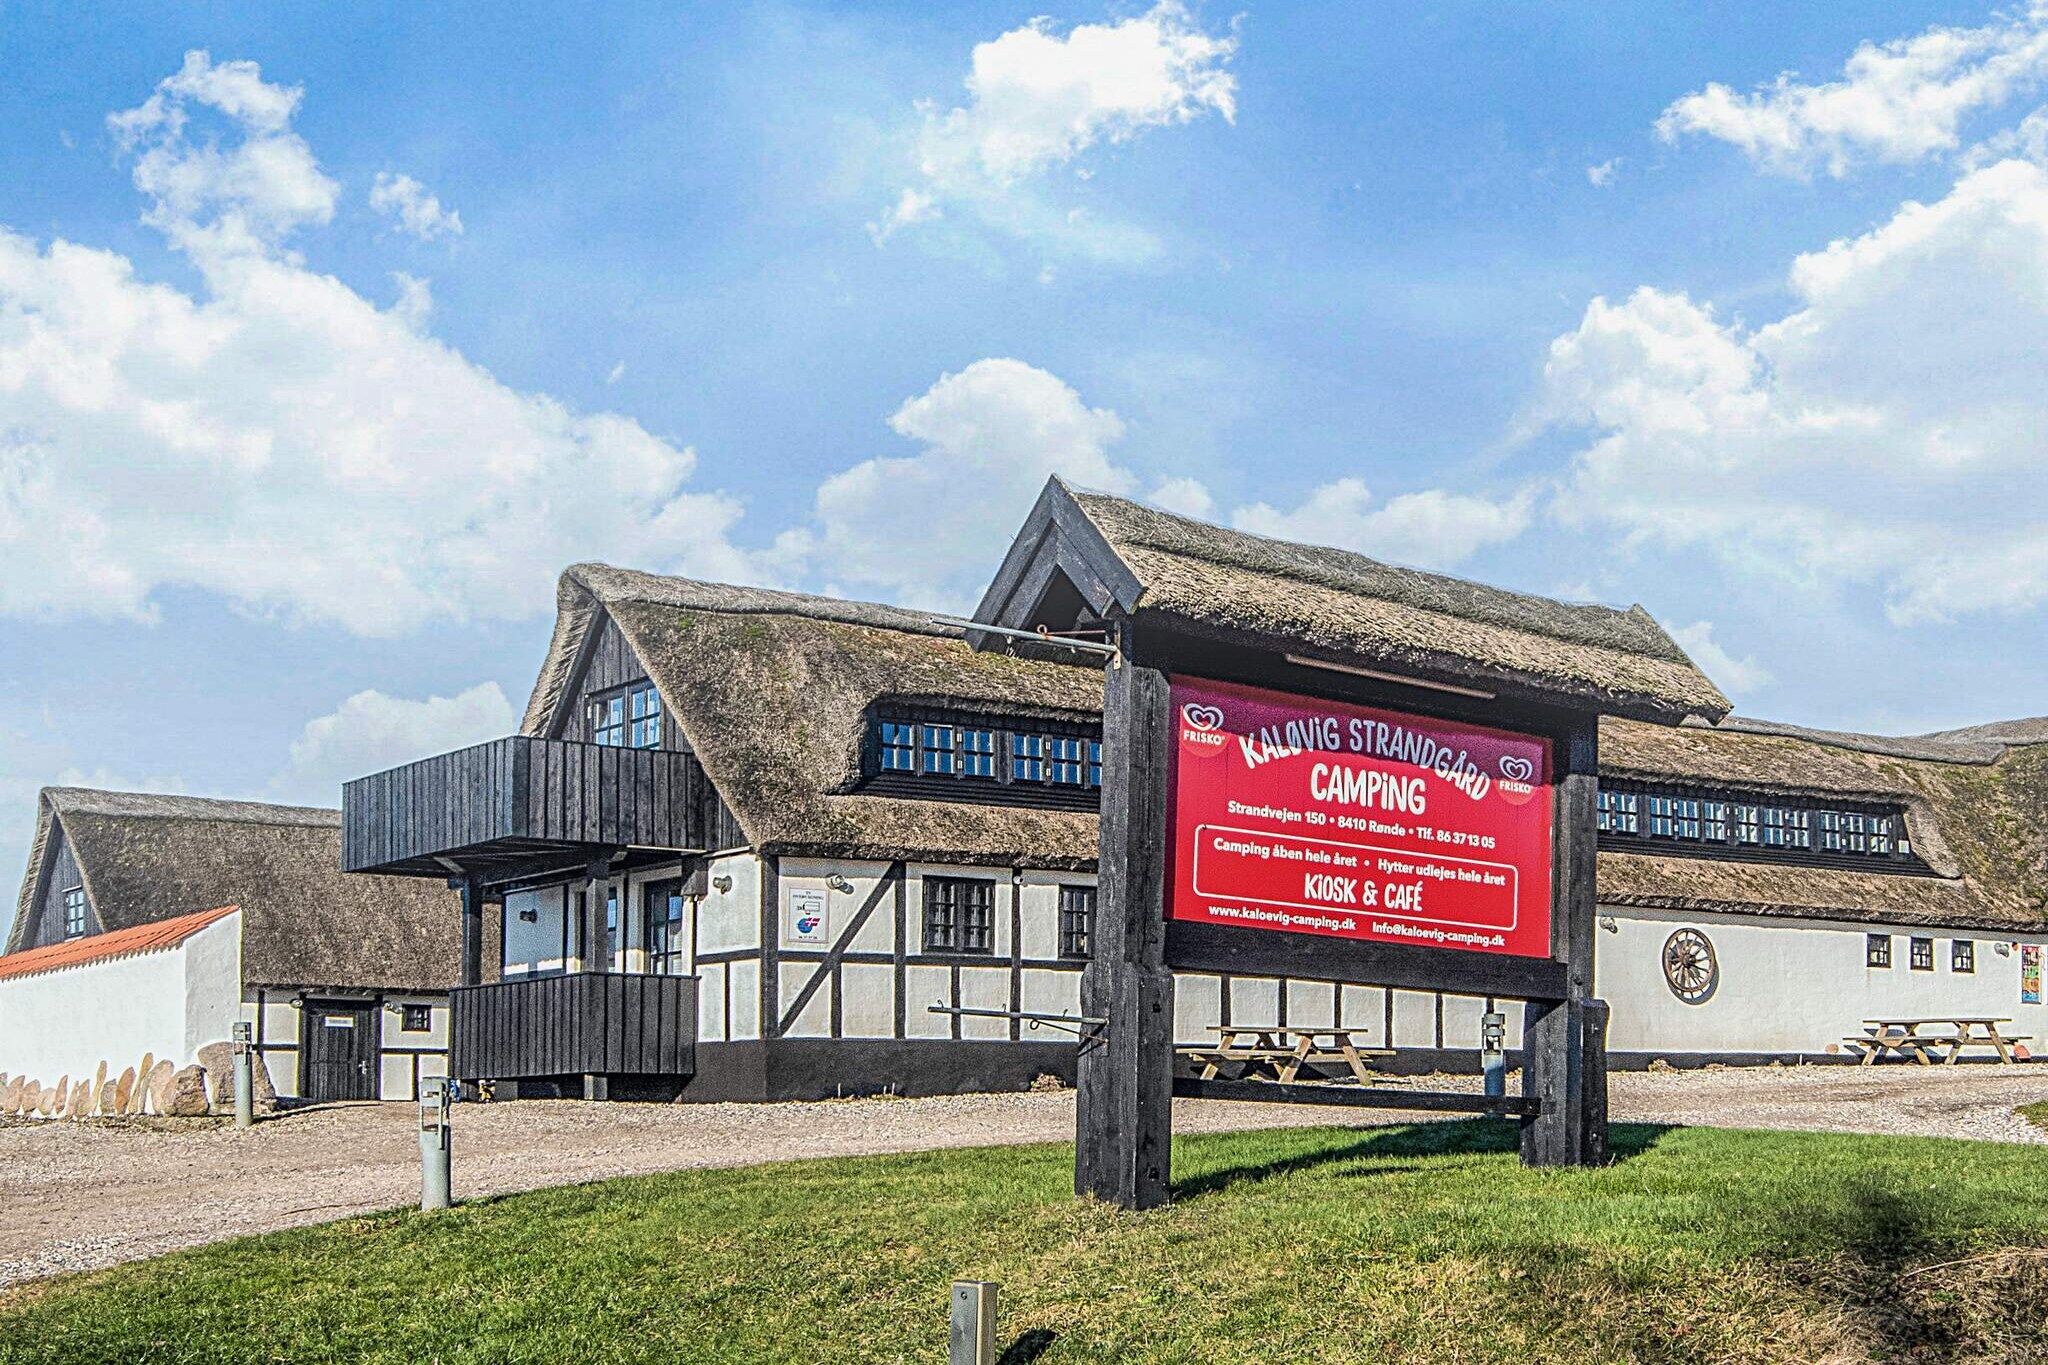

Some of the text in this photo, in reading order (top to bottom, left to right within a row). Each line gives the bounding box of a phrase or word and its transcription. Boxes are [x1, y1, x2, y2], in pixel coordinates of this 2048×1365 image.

[1183, 729, 1223, 746] FRISKO
[1350, 718, 1491, 801] STRANDGÅRD
[1499, 780, 1531, 794] FRISKO
[1228, 800, 1302, 823] Strandvejen
[1304, 811, 1326, 825] 150
[1337, 816, 1366, 831] 8410
[1369, 820, 1406, 836] Rønde
[1416, 826, 1435, 841] Tlf.
[1213, 837, 1506, 886] Camping åben hele året Hytter udlejes hele året
[1362, 880, 1379, 906] &
[1384, 880, 1424, 912] CAFÉ
[1208, 905, 1357, 931] www.kaloevig-camping.dk
